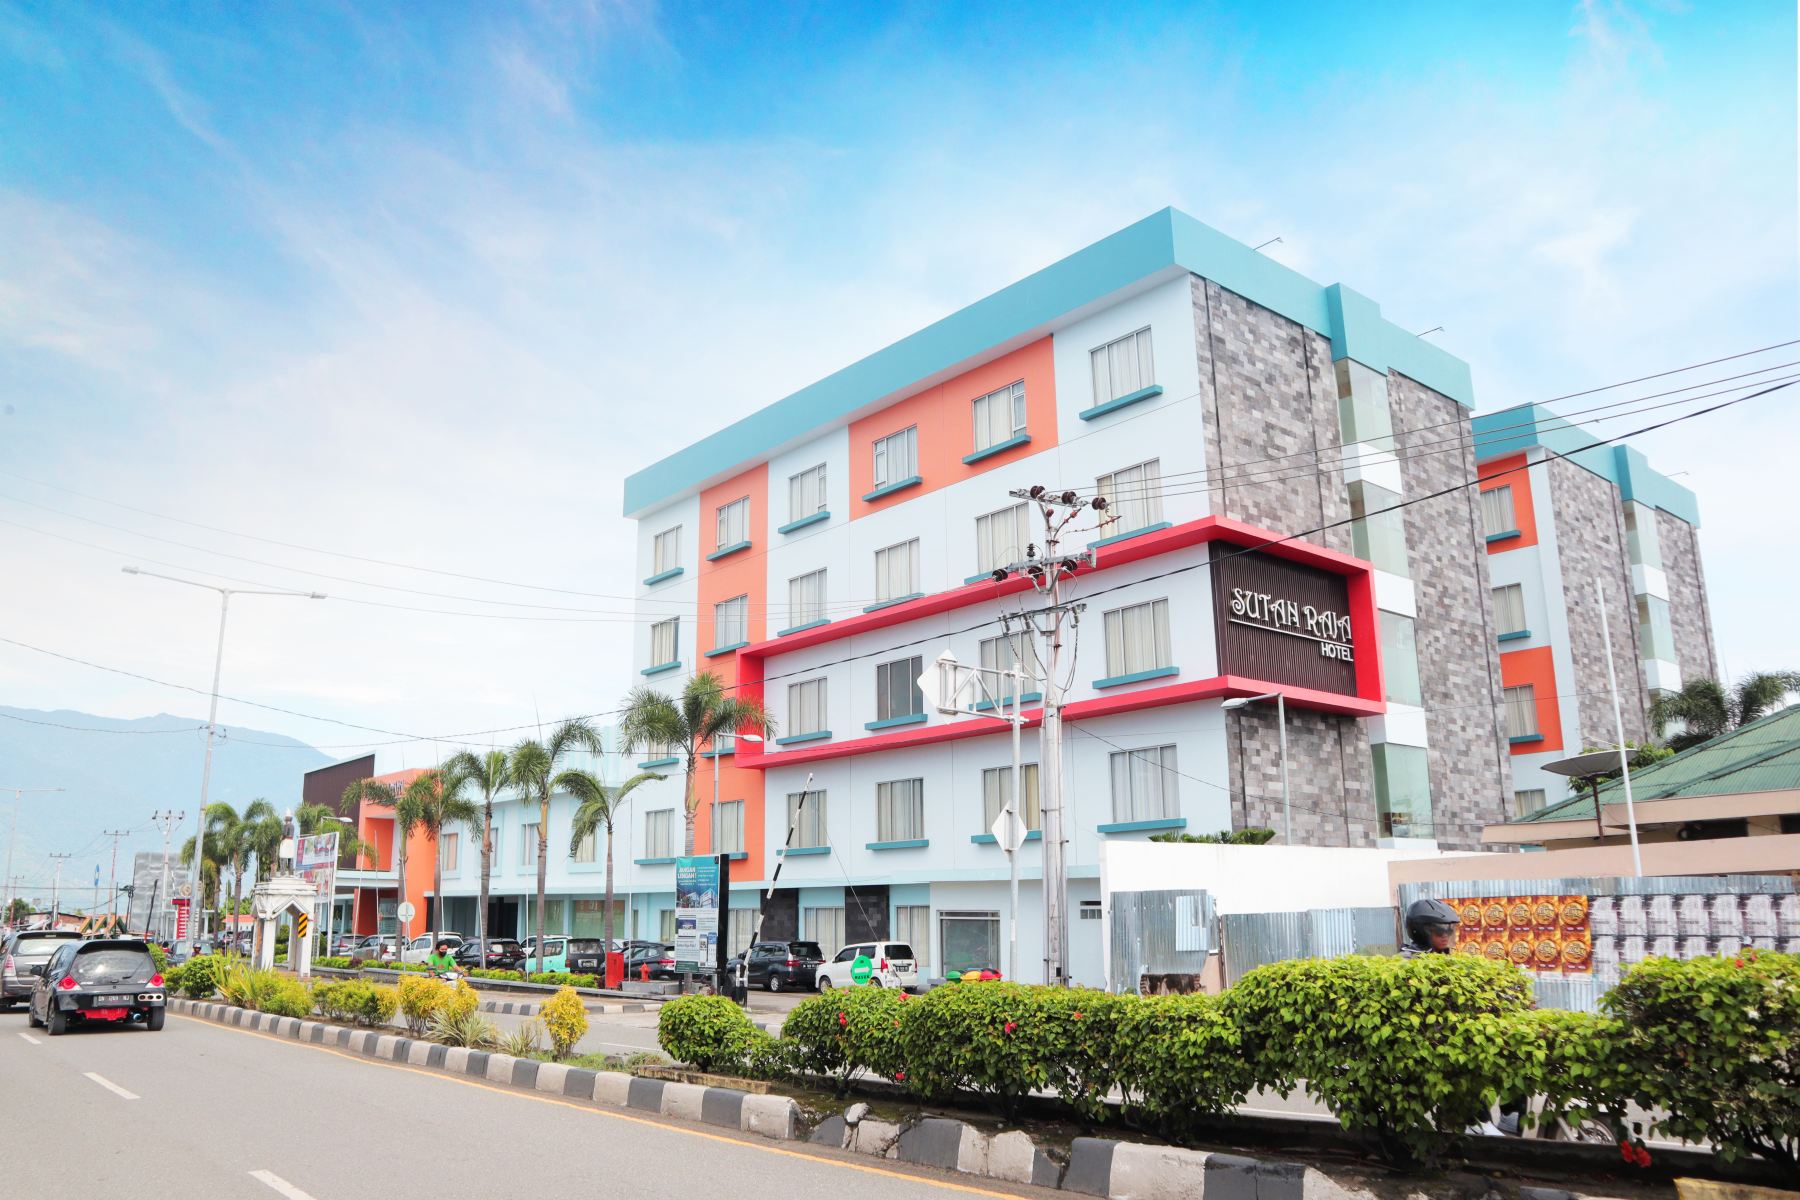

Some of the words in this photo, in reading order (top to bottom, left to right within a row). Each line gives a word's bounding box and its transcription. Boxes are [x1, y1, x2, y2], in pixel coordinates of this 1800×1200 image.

[1231, 587, 1300, 628] SUTAN
[1303, 605, 1353, 642] RAJA
[1321, 642, 1354, 662] HOTEL
